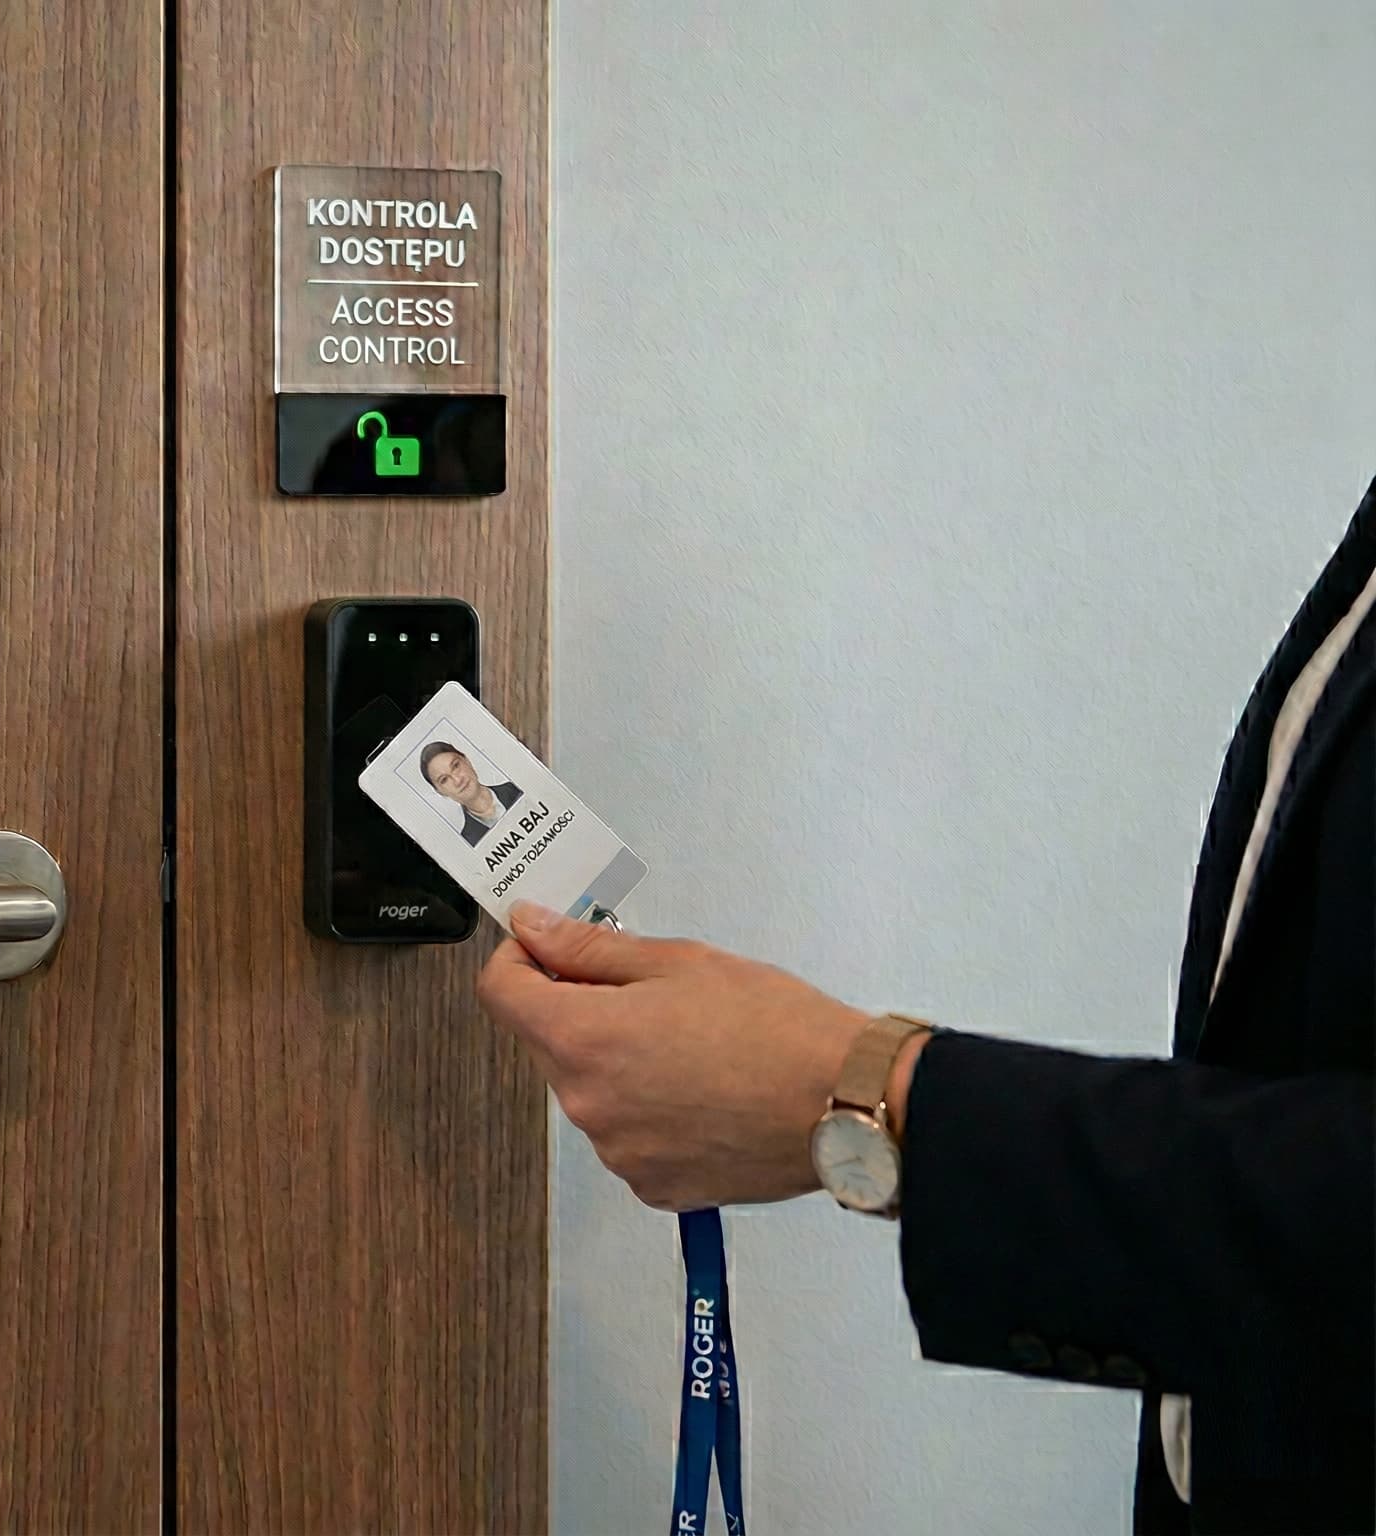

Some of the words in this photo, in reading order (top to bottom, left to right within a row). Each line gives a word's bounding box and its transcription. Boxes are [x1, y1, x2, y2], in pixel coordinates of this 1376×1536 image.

[308, 199, 477, 229] KONTROLA
[319, 236, 465, 272] DOSTĘPU
[331, 295, 454, 327] ACCESS
[319, 336, 465, 365] CONTROL
[485, 831, 525, 872] ANNA
[518, 801, 549, 834] BAJ
[378, 905, 428, 920] roger
[691, 1298, 715, 1399] ROGER
